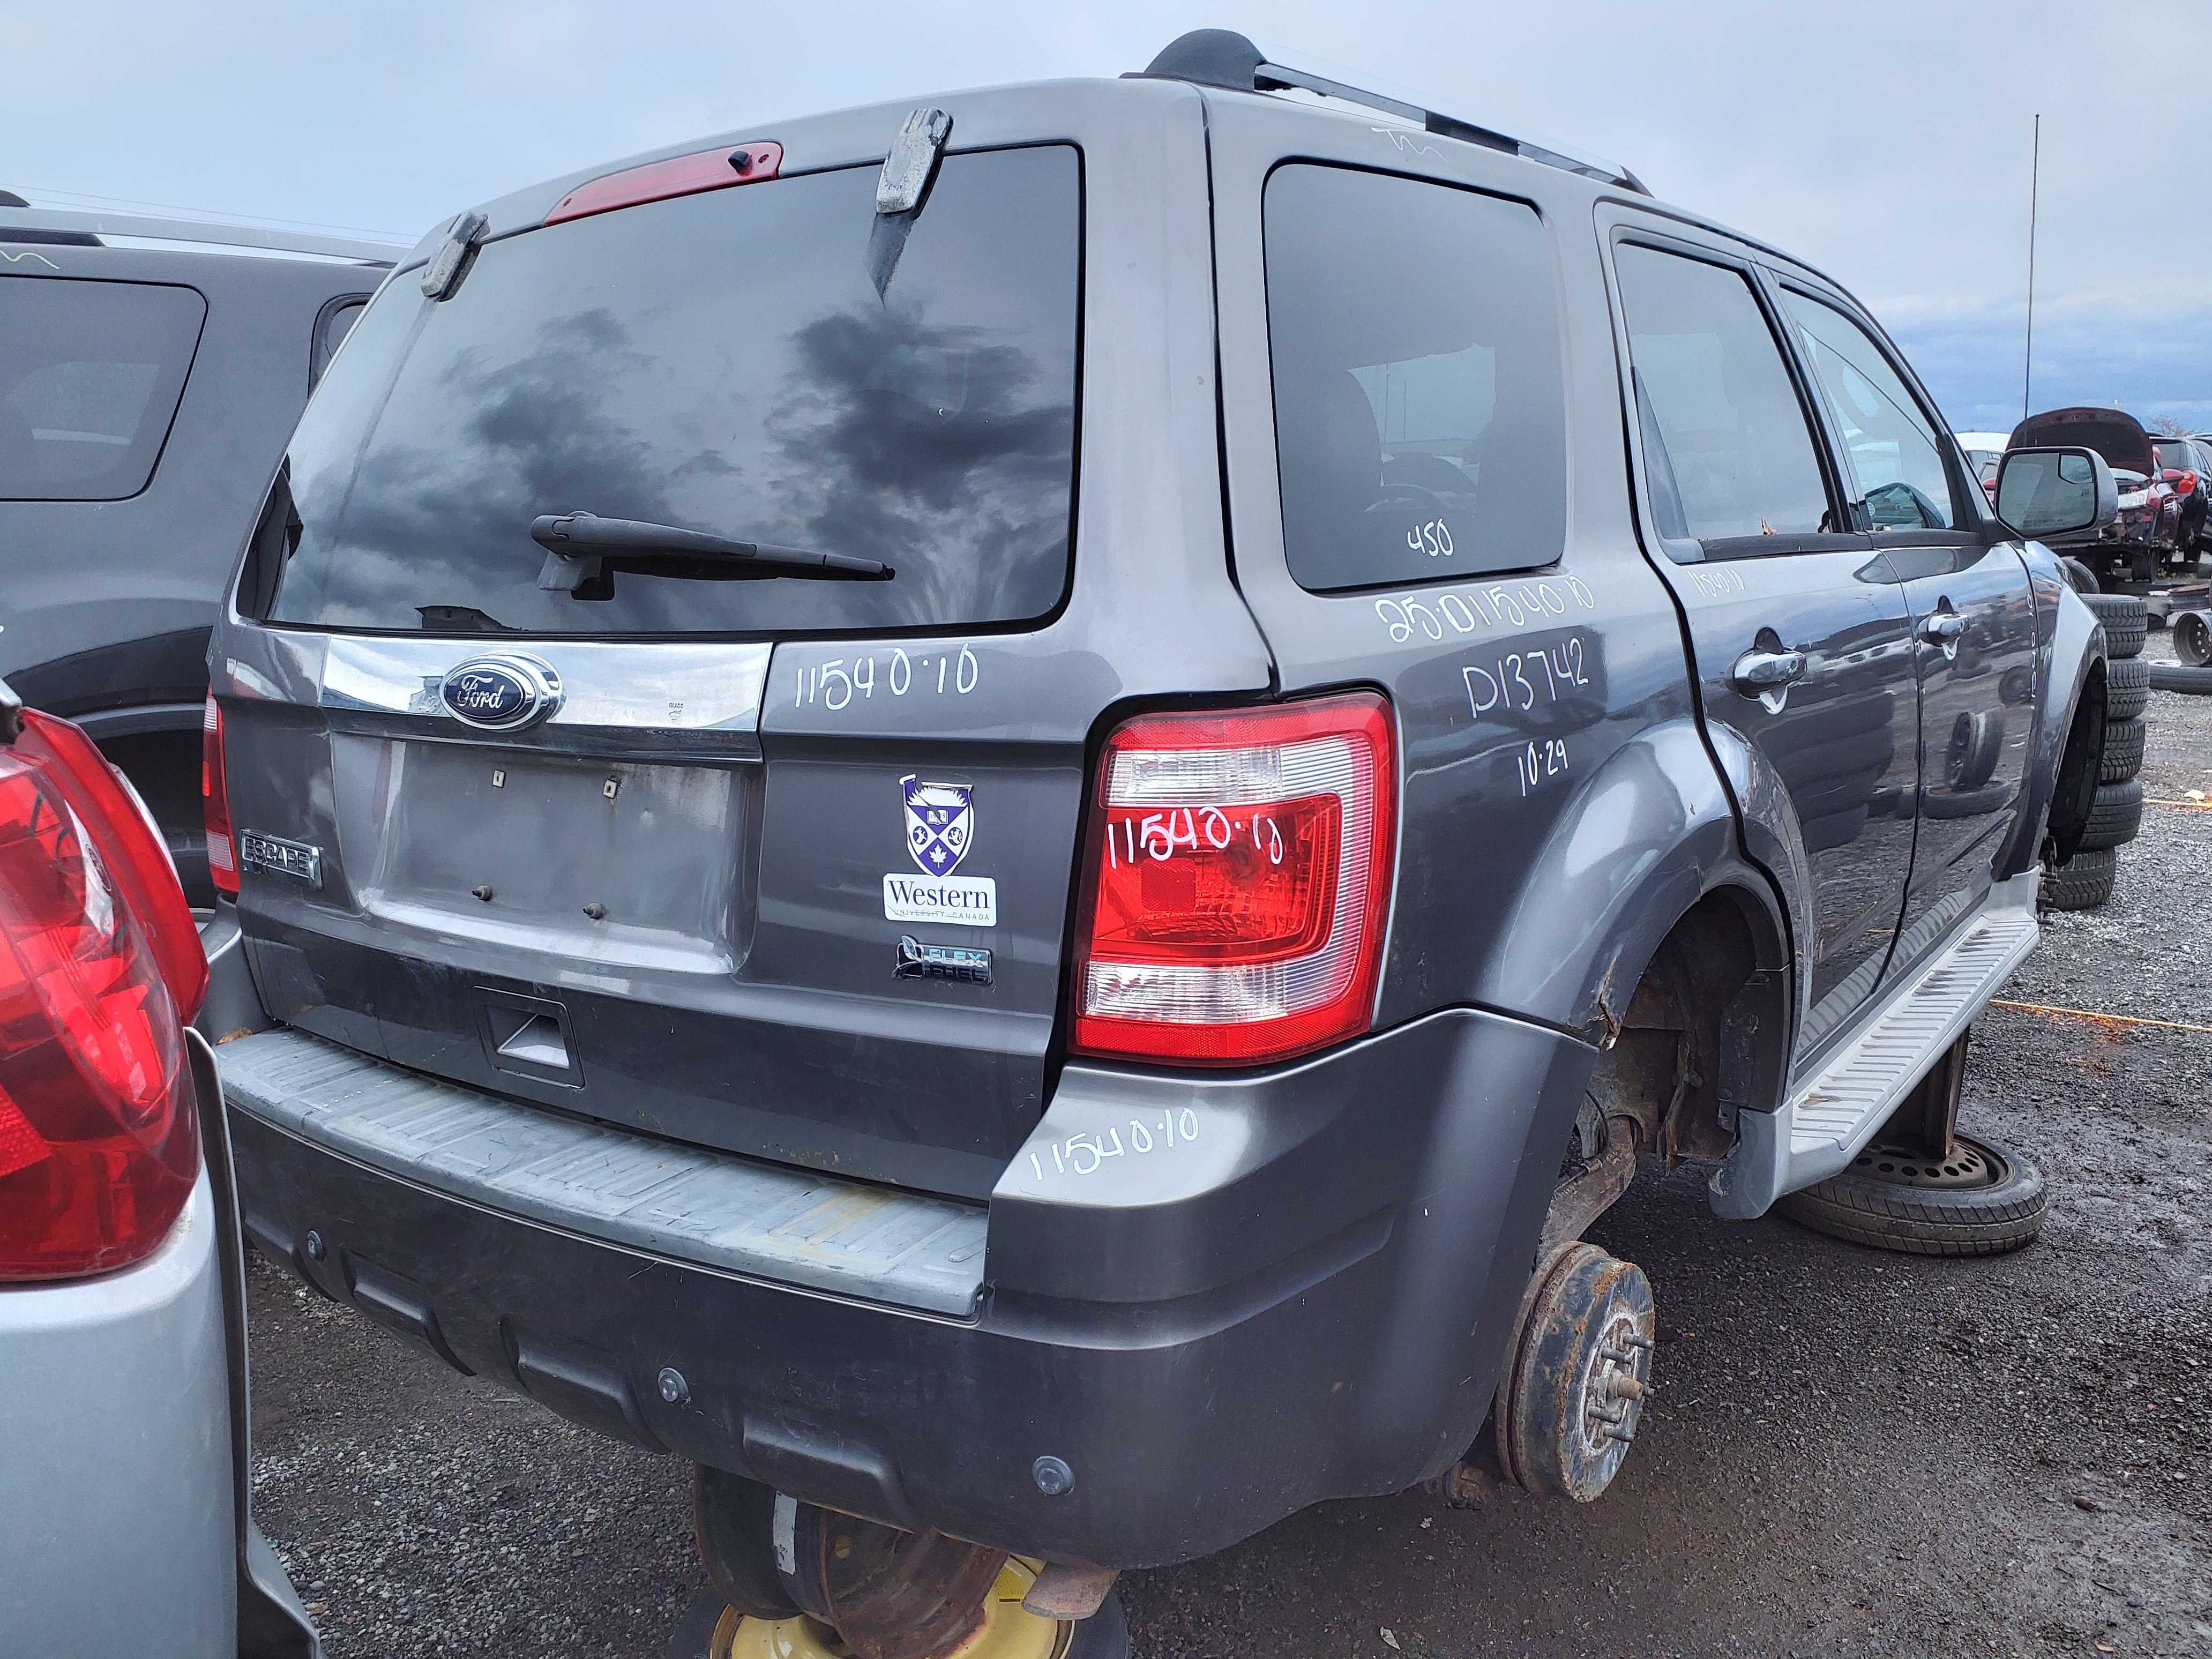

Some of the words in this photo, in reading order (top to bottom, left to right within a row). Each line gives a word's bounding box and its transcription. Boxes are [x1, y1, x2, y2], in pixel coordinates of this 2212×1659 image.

[1407, 518, 1454, 557] 450
[457, 674, 505, 709] Ford
[795, 643, 978, 710] 11540.10
[1462, 637, 1590, 719] D13742
[244, 836, 310, 871] ESCAPE
[887, 880, 990, 909] Western
[952, 912, 990, 921] CANADA
[929, 948, 984, 968] FLEX
